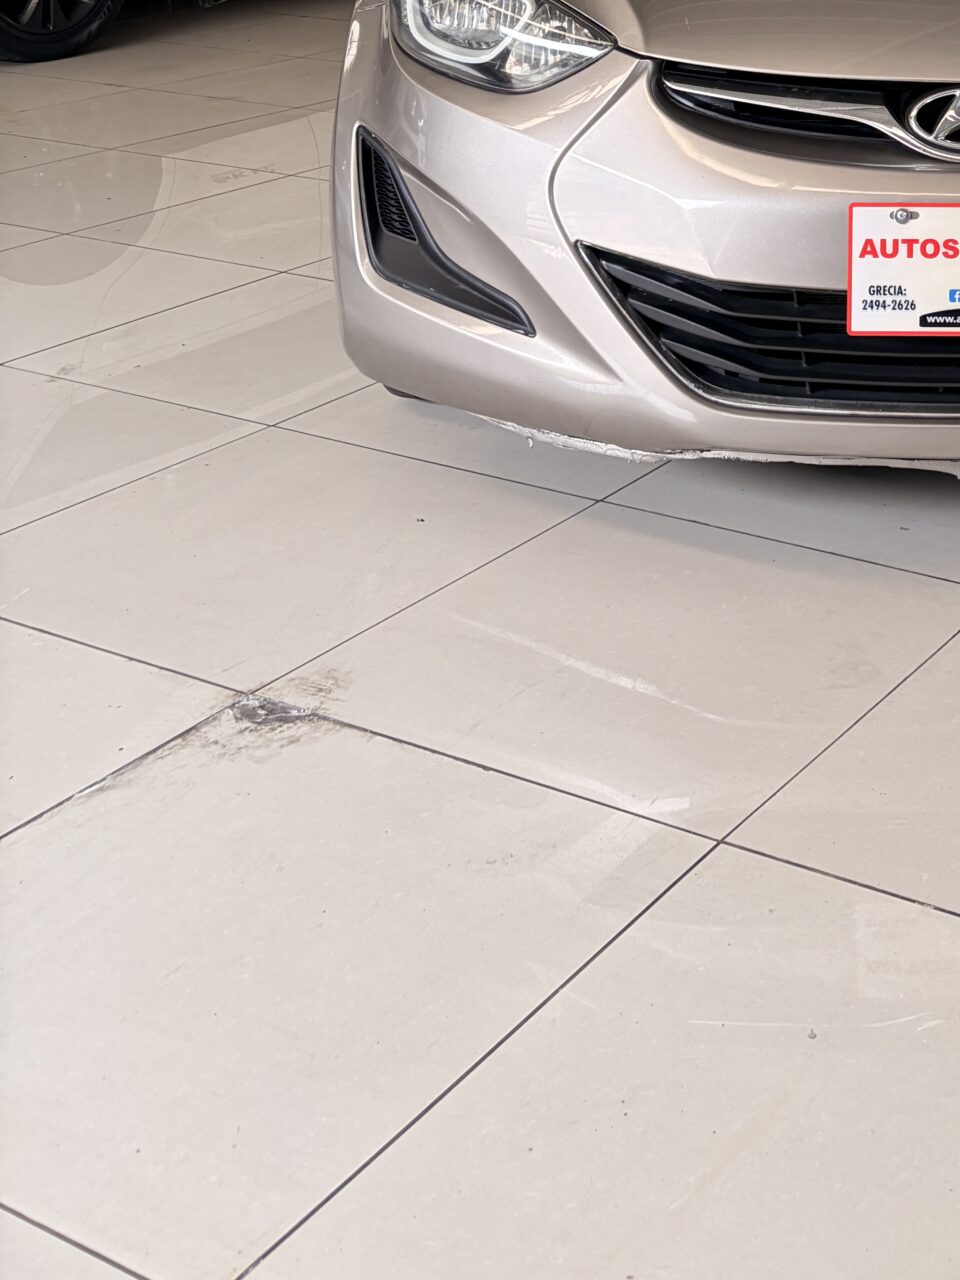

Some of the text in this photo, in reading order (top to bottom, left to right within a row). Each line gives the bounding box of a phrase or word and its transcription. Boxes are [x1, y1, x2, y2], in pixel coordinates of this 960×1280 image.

[859, 238, 960, 260] AUTOS
[868, 285, 907, 297] GRECIA:
[862, 300, 917, 311] 2494-2626
